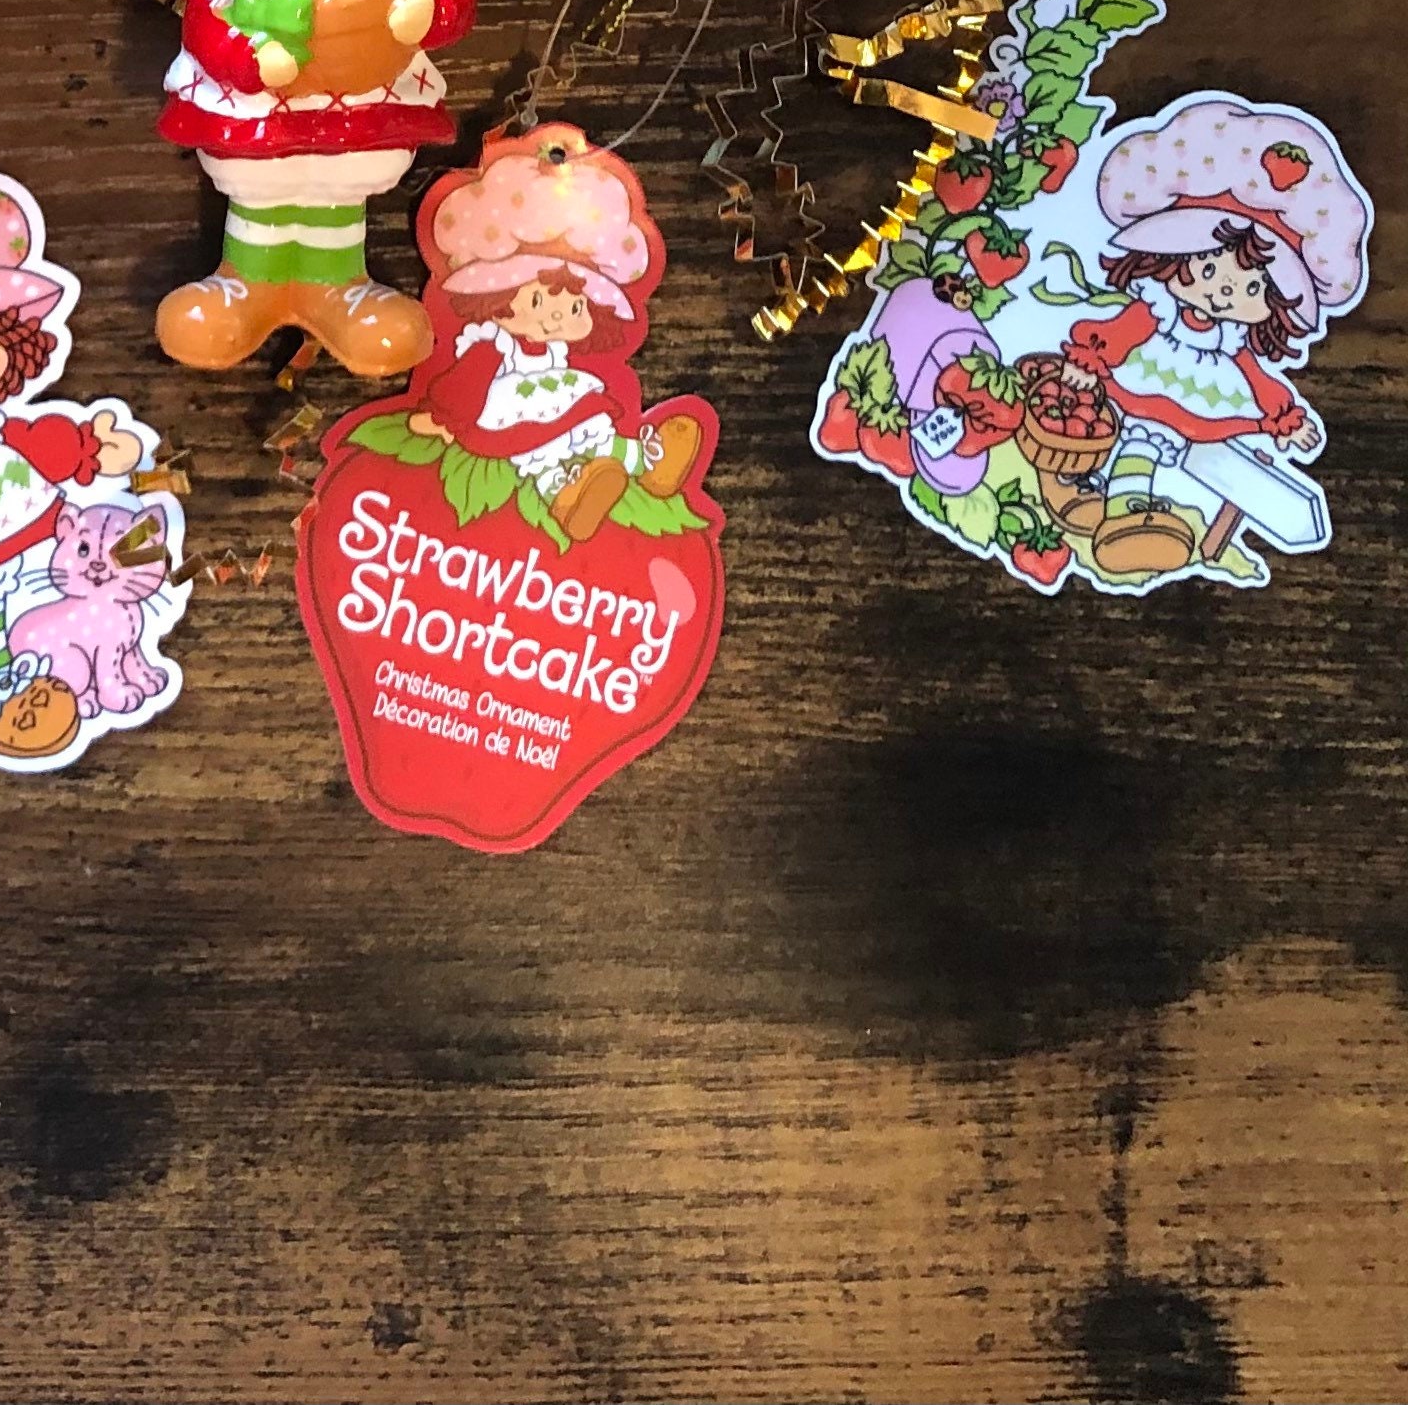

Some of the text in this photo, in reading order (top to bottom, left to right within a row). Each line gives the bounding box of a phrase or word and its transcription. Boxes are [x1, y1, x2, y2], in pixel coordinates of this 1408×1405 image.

[337, 562, 640, 714] Shortcake
[338, 490, 681, 675] Strawberry
[373, 691, 561, 771] Décoration de Noël
[374, 660, 571, 742] Christmas Ornament
